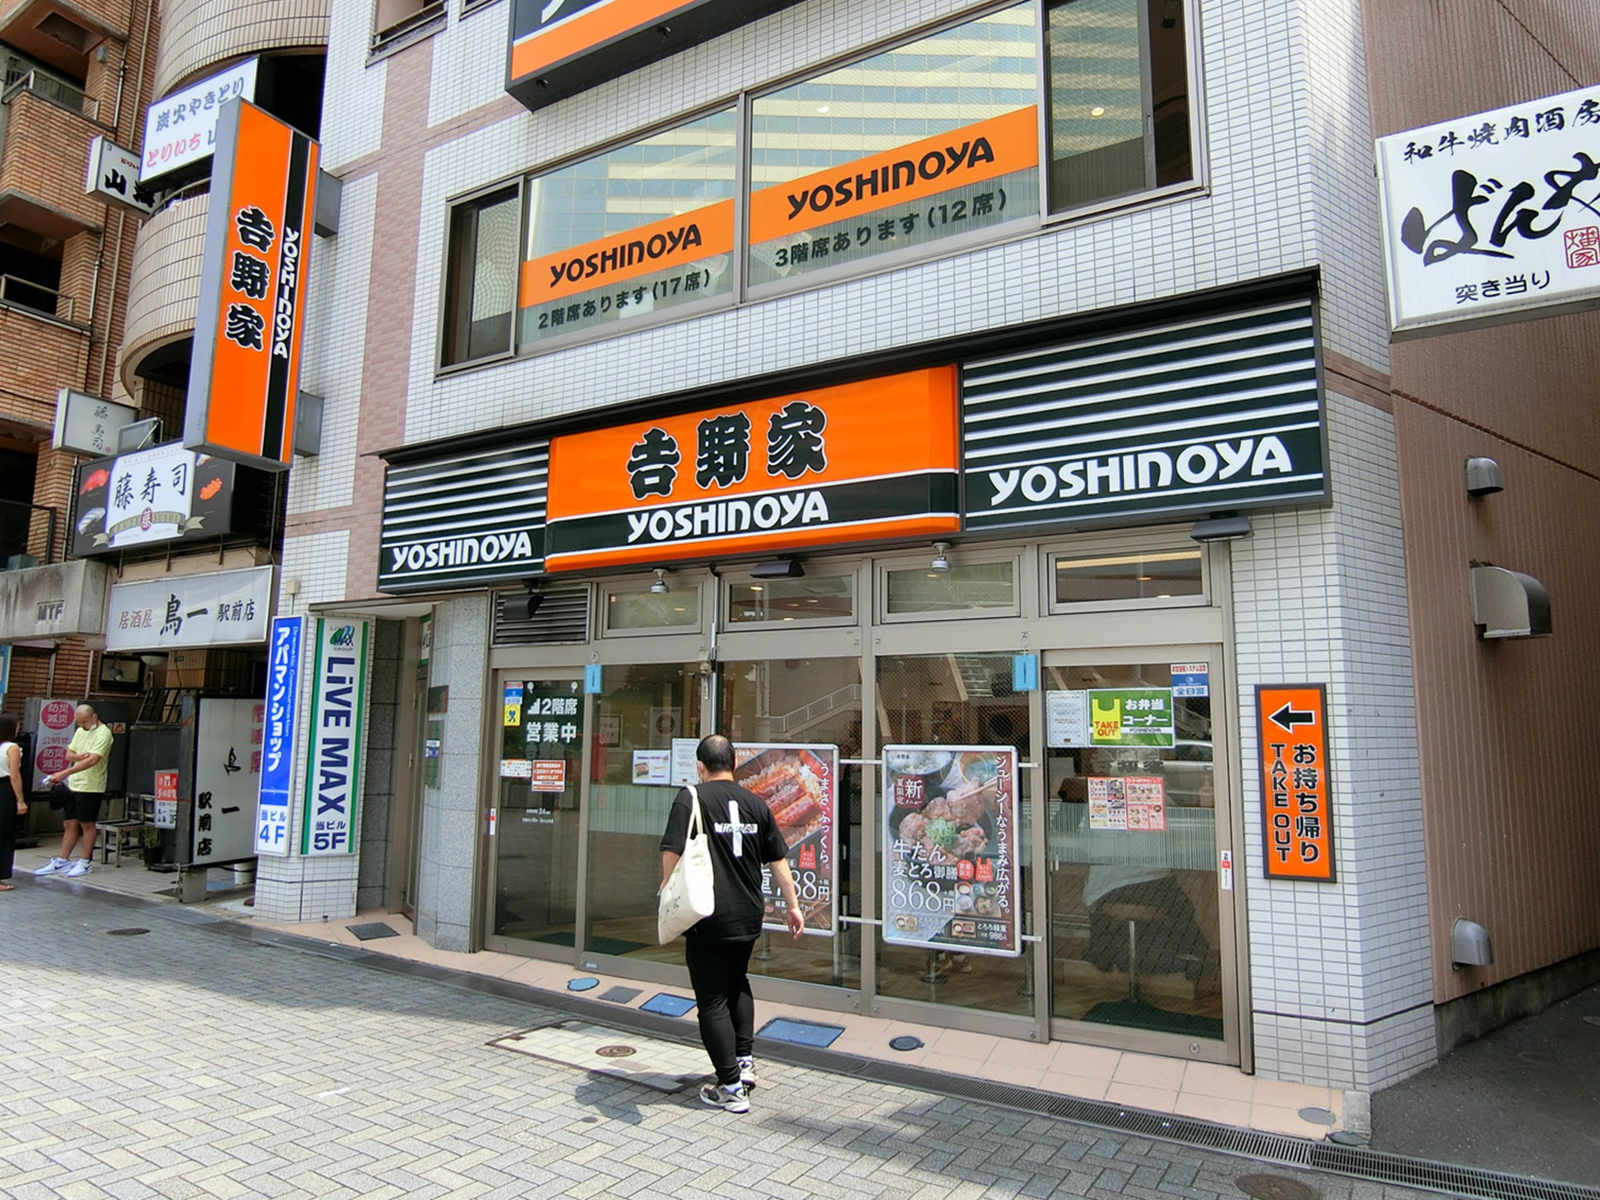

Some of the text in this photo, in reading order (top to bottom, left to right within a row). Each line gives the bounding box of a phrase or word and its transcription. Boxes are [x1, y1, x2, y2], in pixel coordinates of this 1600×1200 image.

[156, 77, 244, 132] 炭火やきとり
[146, 133, 200, 168] とりいち
[787, 137, 995, 220] YOSHINOYA
[550, 223, 703, 289] YOSHINOYA
[273, 226, 299, 359] YOSHINOYA
[1455, 270, 1551, 305] 突き当り
[113, 462, 188, 510] 藤寿司
[988, 435, 1293, 507] YOSHINOYA
[627, 490, 829, 544] YOSHINOYA
[391, 531, 533, 573] YOSHINOYA
[118, 593, 256, 636] 居酒屋 鳥一 駅前店
[266, 626, 291, 772] アパマンショップ
[541, 697, 578, 716] 2階席
[1125, 698, 1166, 711] お弁当
[526, 721, 577, 744] 営業中
[1094, 721, 1119, 730] TAKE
[1097, 729, 1117, 737] OUT
[1122, 715, 1168, 726] コーナー
[317, 737, 350, 816] MAX
[904, 778, 923, 799] 新
[261, 810, 287, 822] 当ビル
[1270, 743, 1291, 862] TAKE OUT
[1292, 743, 1320, 863] お持ち帰り
[313, 832, 347, 851] 5F
[315, 820, 347, 831] 当ビル
[893, 839, 946, 862] 牛たん
